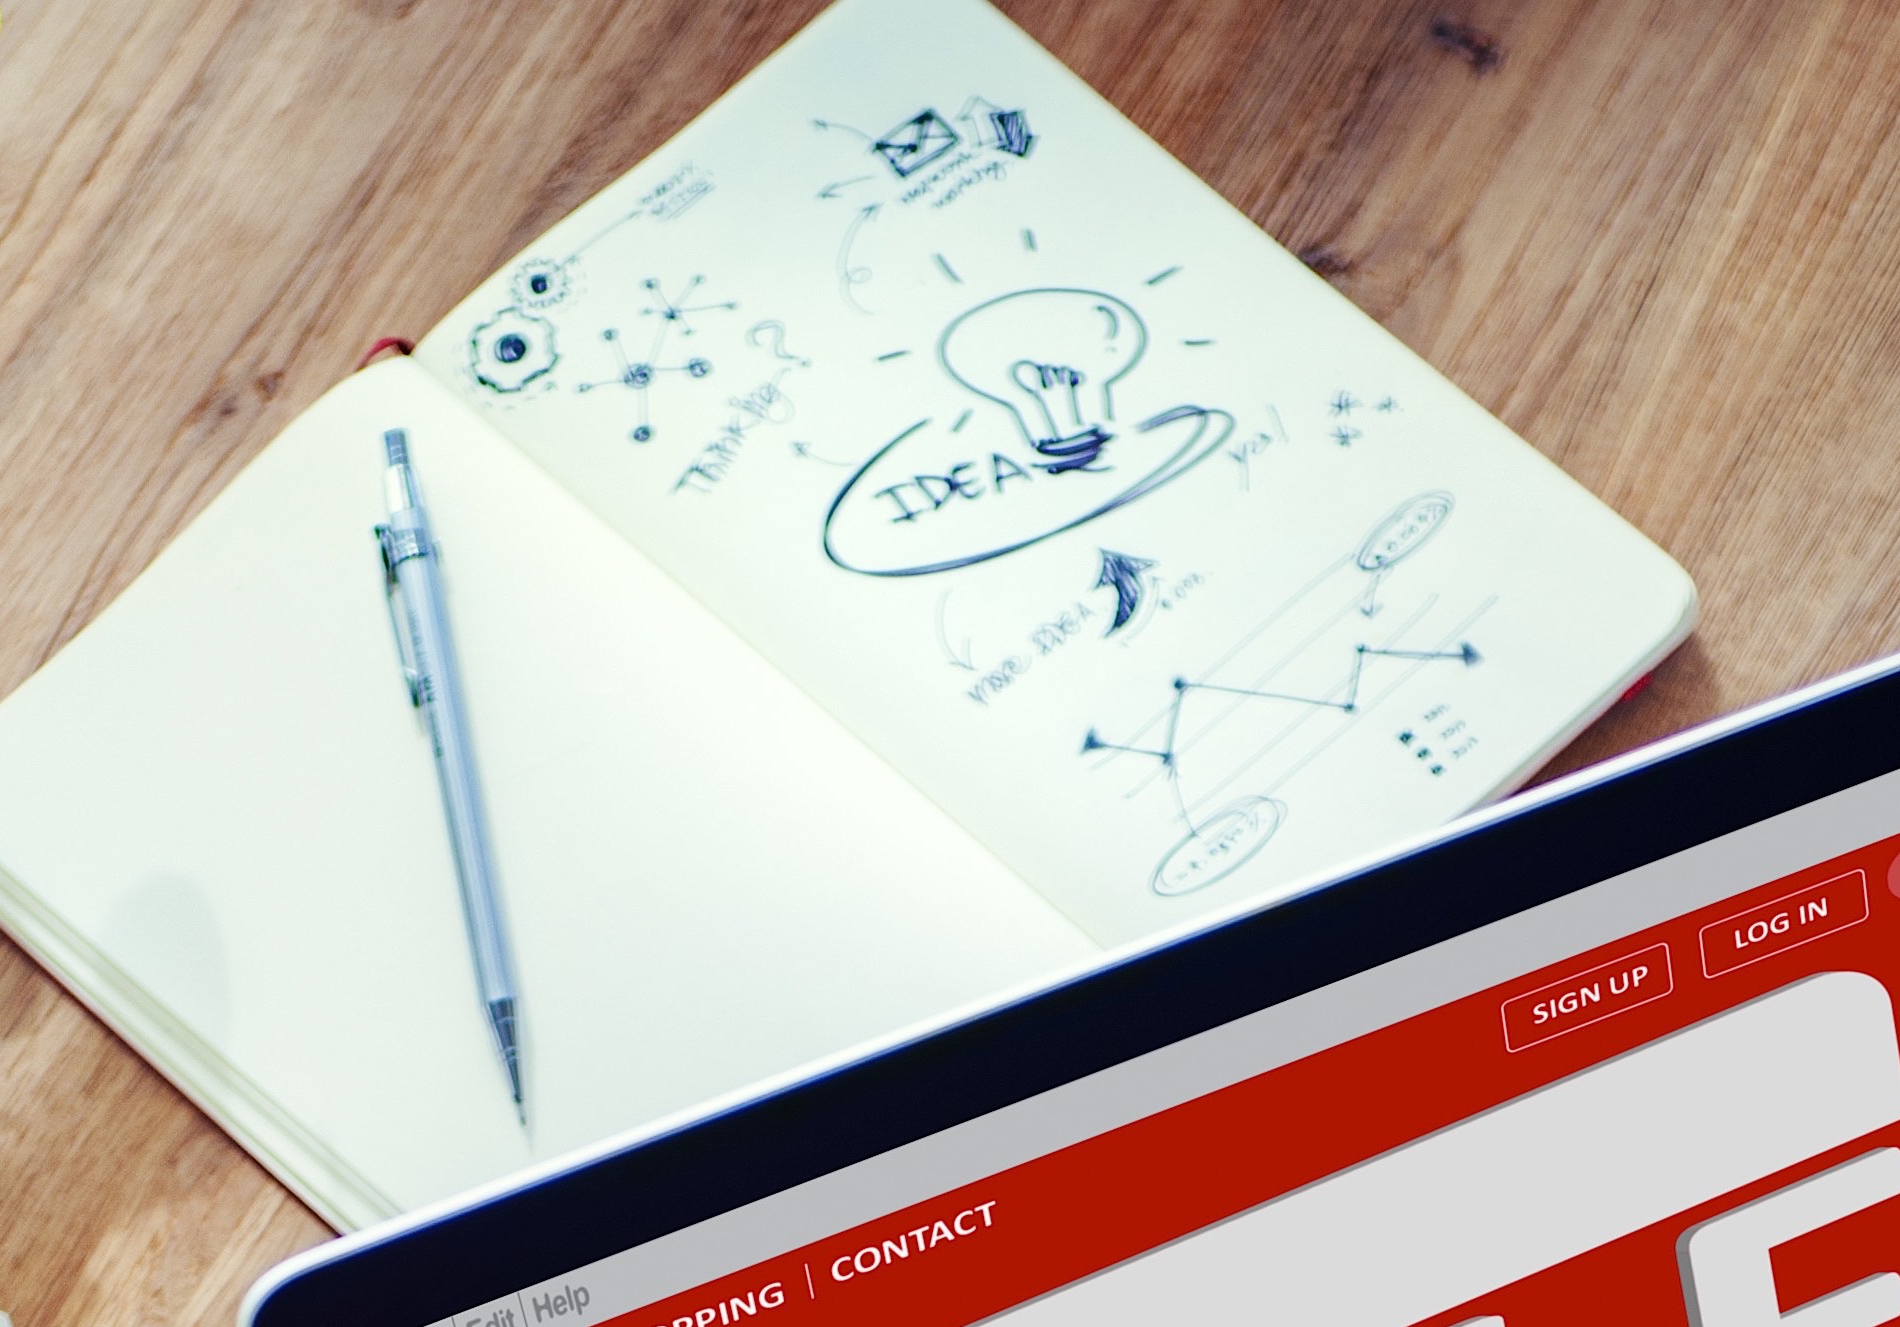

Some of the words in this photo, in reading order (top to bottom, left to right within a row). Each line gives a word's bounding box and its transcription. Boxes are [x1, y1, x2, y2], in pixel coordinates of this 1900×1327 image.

[873, 451, 1032, 523] IDEA
[1732, 911, 1791, 952] LOG
[1798, 897, 1829, 925] IN
[1532, 977, 1602, 1026] SIGN
[1608, 964, 1650, 997] UP
[829, 1200, 998, 1284] CONTACT
[531, 1281, 592, 1324] Help
